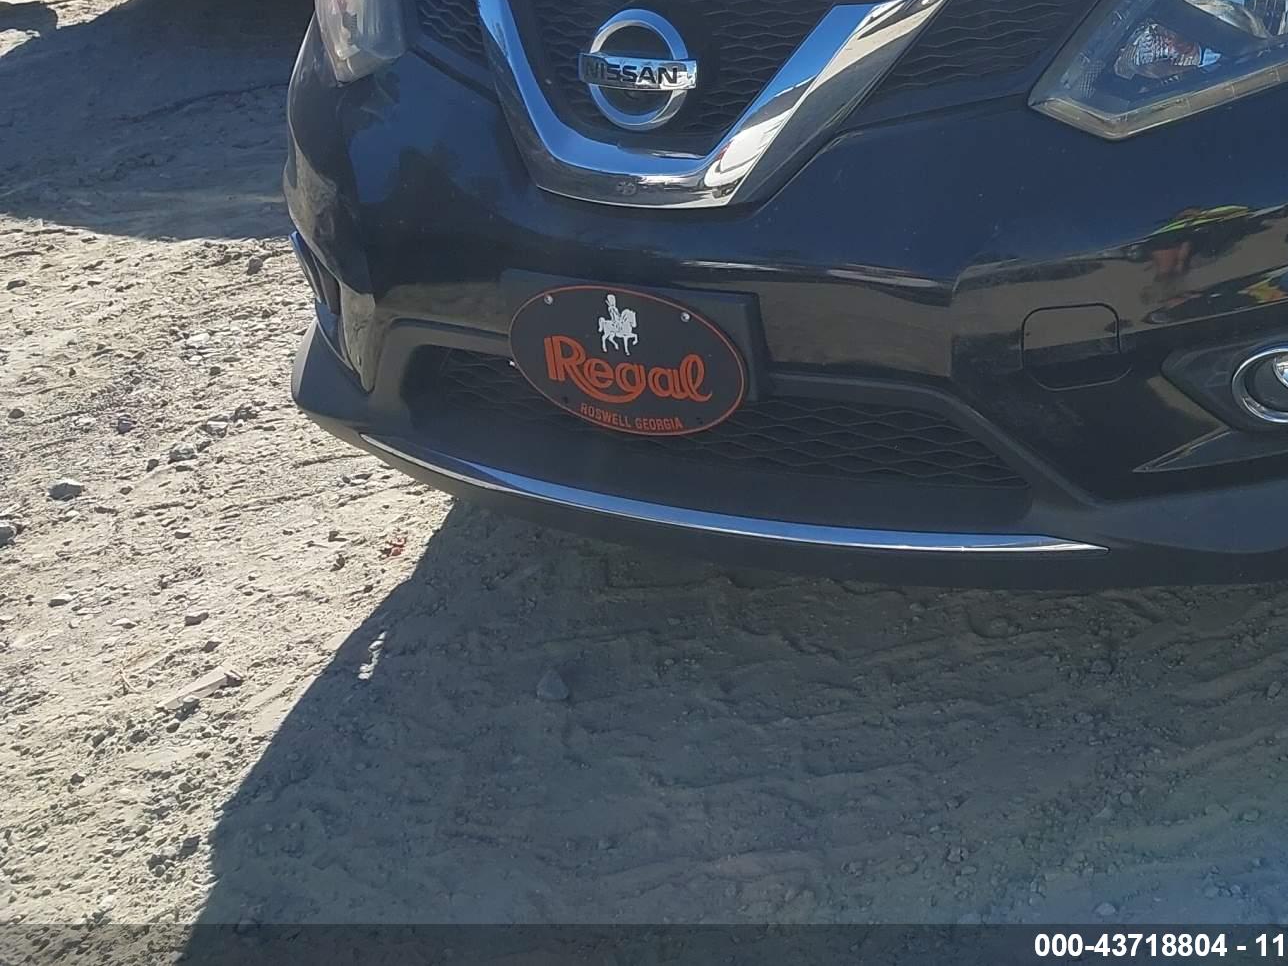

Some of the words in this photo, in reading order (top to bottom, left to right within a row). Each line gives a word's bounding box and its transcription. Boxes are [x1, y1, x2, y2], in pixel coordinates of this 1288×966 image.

[584, 62, 677, 83] NISSAN
[544, 335, 712, 403] Regal
[580, 402, 632, 428] ROSWELL
[635, 417, 683, 430] GEORGIA
